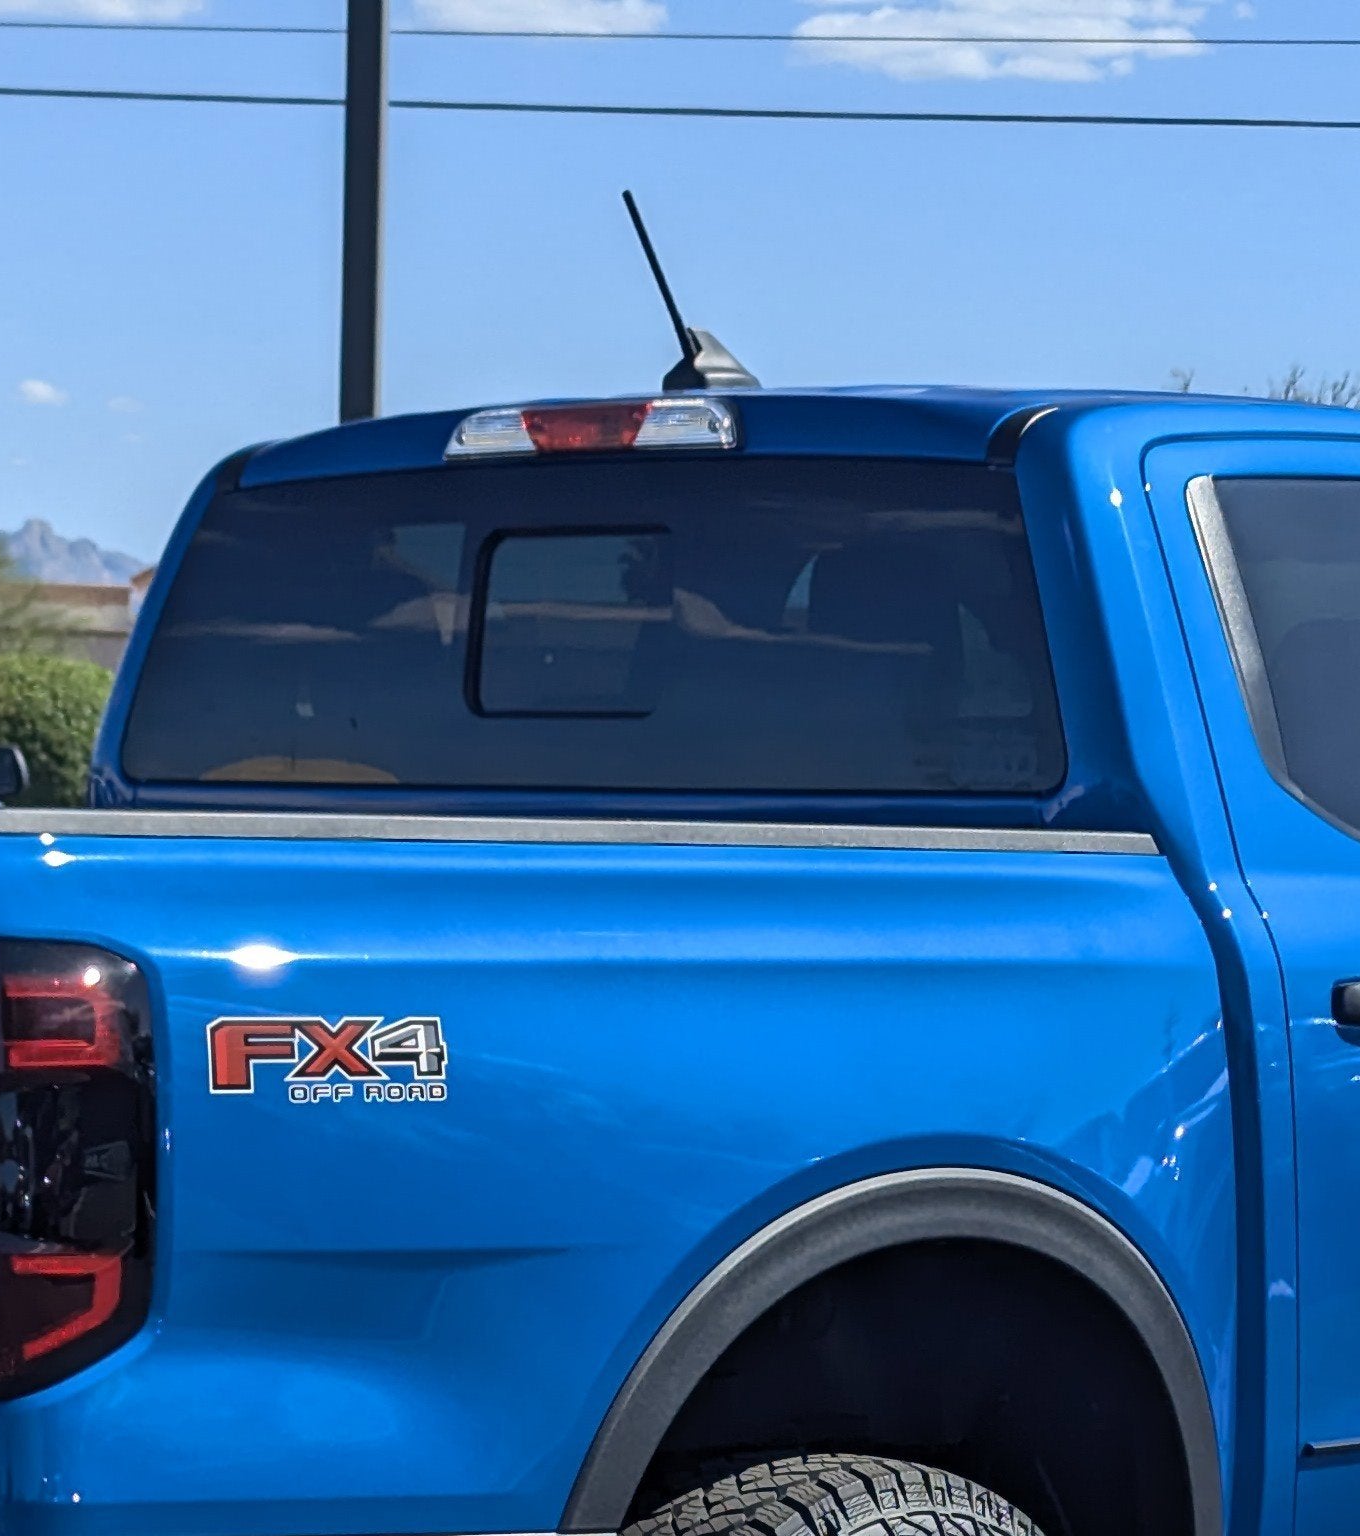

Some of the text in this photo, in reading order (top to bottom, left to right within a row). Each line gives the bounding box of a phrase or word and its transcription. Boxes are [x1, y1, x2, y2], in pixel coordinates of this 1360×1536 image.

[207, 1016, 448, 1094] FX4
[288, 1083, 448, 1103] OFF ROAD
